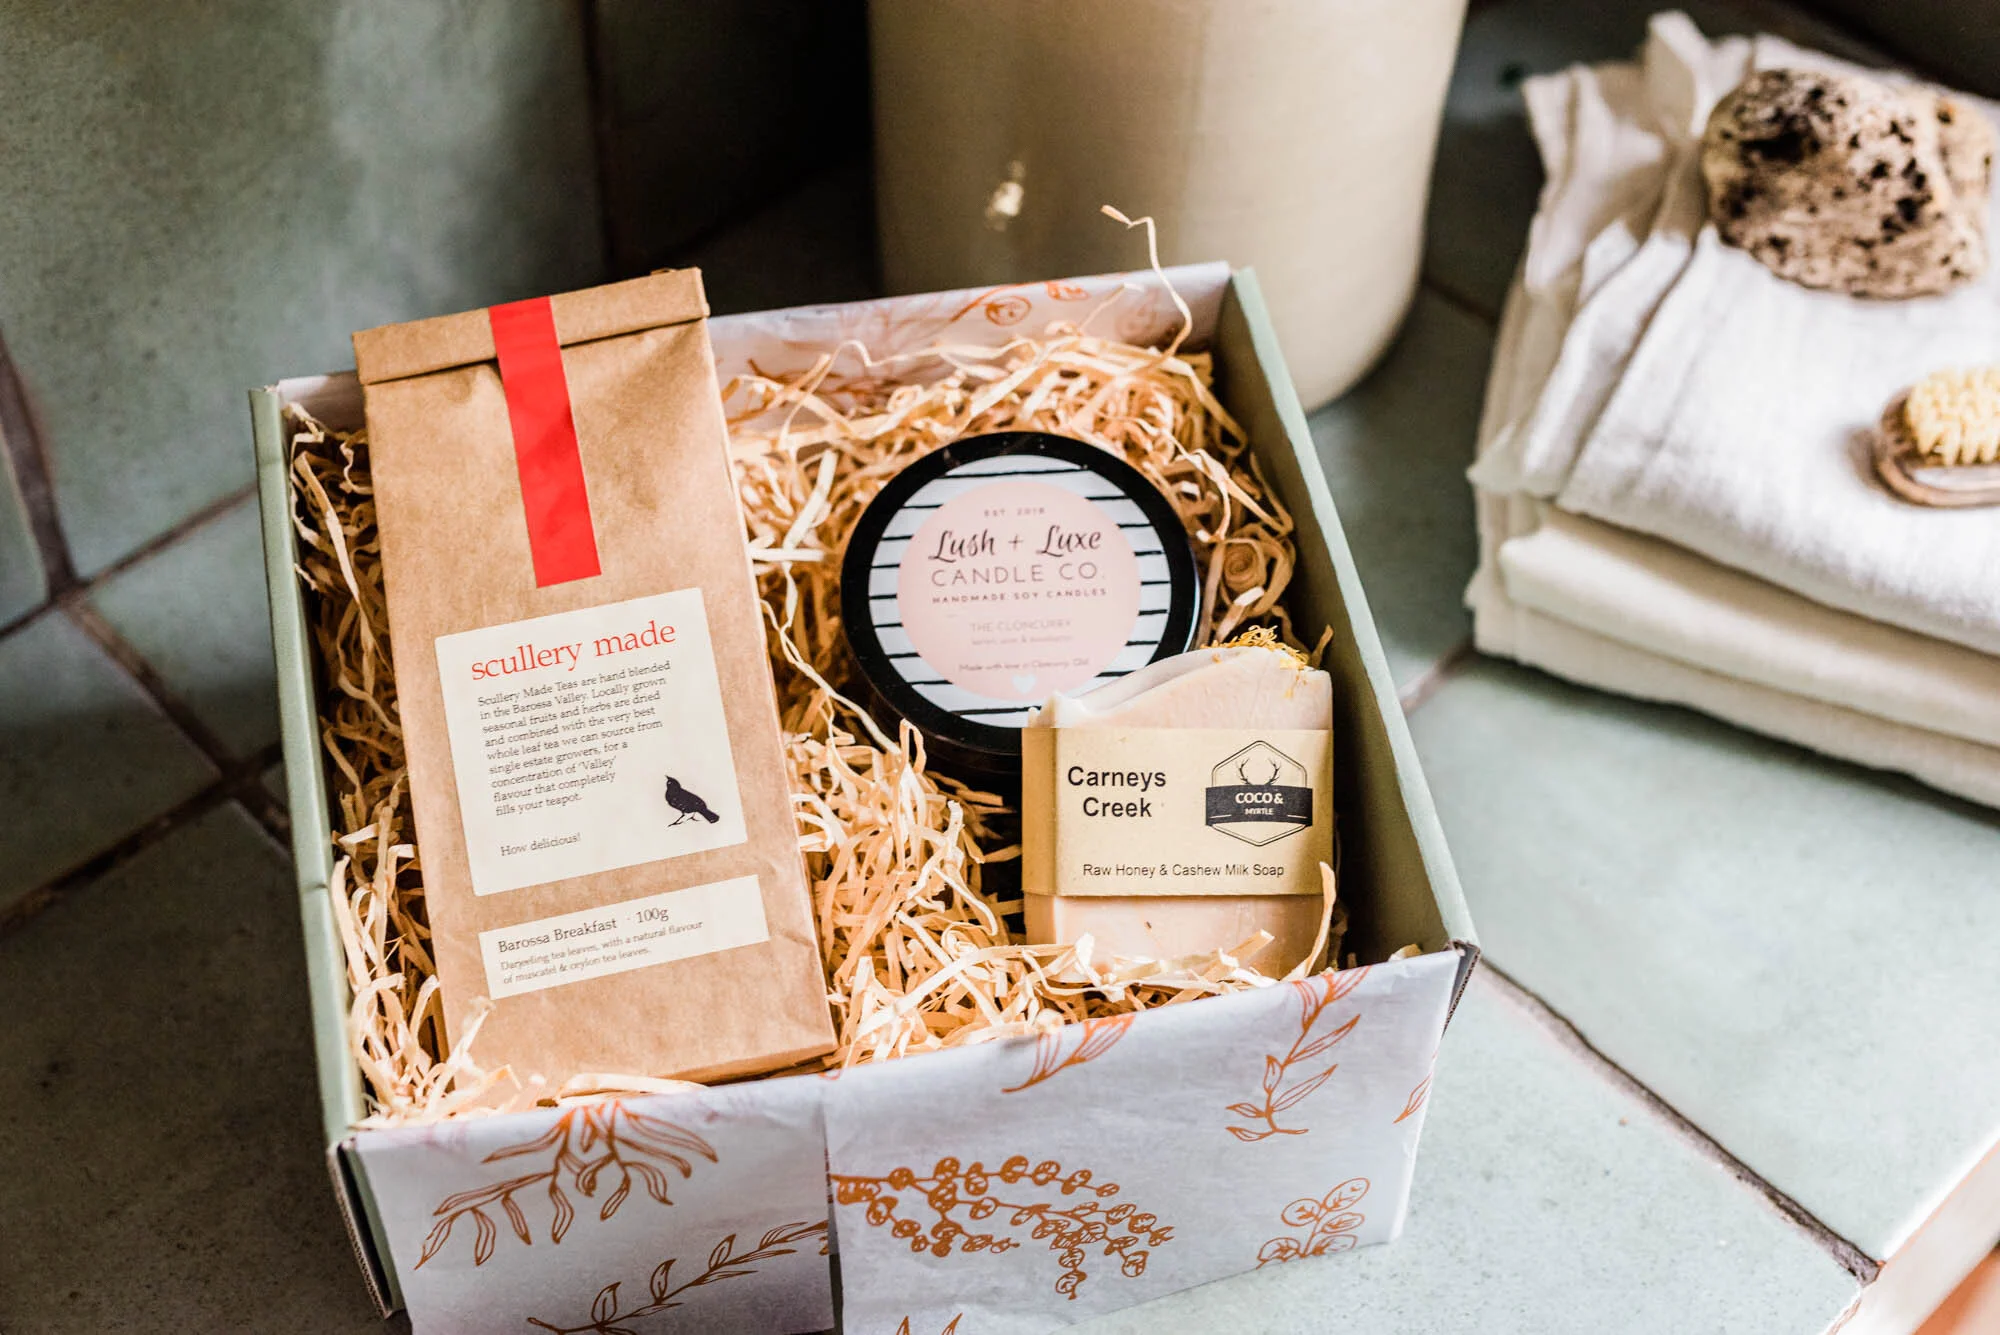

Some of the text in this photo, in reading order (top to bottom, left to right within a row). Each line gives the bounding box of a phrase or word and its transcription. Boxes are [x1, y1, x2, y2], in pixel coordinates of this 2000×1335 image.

[928, 529, 995, 563] Lush
[1035, 525, 1101, 557] Luxe
[931, 565, 1044, 586] CANDLE
[933, 593, 1006, 603] HANDMADE
[1047, 588, 1107, 598] CANDLES
[471, 620, 676, 680] scullery made
[478, 660, 671, 706] Scullery Made Teas are hand blended
[482, 690, 661, 733] seasonal fruits and herbs are dried
[493, 707, 510, 717] the
[512, 701, 552, 713] Barossa
[592, 684, 629, 698] Locally
[632, 679, 666, 693] grown
[485, 707, 656, 747] and combined with the very best
[487, 747, 519, 760] whole
[522, 741, 541, 754] leaf
[544, 741, 559, 749] tea
[580, 733, 599, 742] can
[601, 726, 635, 738] source
[637, 721, 663, 731] from
[489, 761, 521, 774] single
[523, 756, 553, 768] estate
[604, 743, 619, 752] for
[491, 769, 563, 788] concentration
[565, 763, 576, 774] of
[494, 771, 615, 802] flavour that completely
[1068, 766, 1166, 792] Carneys
[496, 804, 515, 816] fills
[518, 801, 543, 814] your
[1083, 797, 1152, 818] Creek
[500, 845, 527, 856] How
[1083, 864, 1284, 878] Raw Honey & Cashew Milk Soap
[498, 908, 669, 952] Barossa Breakfast 100g
[601, 937, 623, 948] with
[632, 927, 666, 942] natural
[668, 922, 703, 934] flavour
[504, 974, 512, 984] of
[516, 965, 557, 981] muscatel
[559, 963, 568, 972] &
